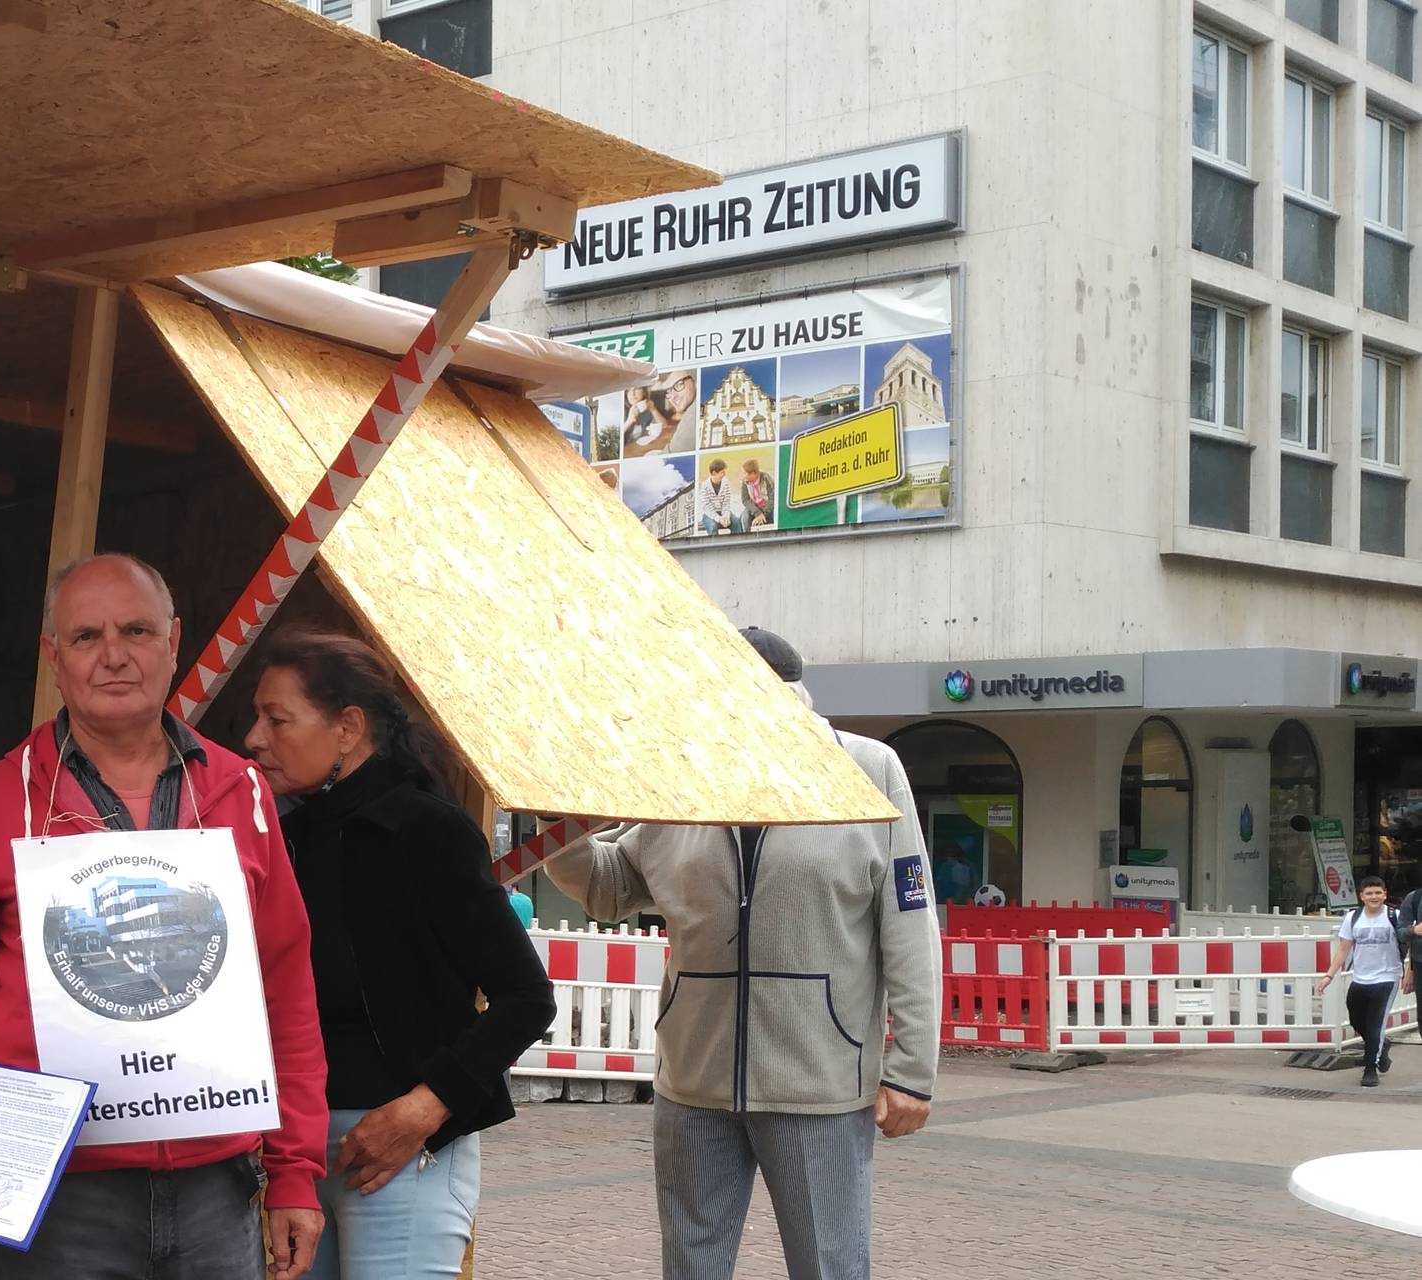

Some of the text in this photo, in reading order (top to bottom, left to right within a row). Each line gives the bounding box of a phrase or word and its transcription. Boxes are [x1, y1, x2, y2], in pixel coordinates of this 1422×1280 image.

[563, 163, 922, 270] NEUE RUHR ZEITUNG
[670, 311, 864, 363] HIER ZU HAUSE
[819, 431, 868, 456] Redaktion
[798, 448, 890, 486] Mülheim a. d. Ruhr
[981, 670, 1126, 701] unitymedia
[71, 855, 178, 885] Bürgerbegehren
[53, 933, 222, 1017] Erhalt unserer VHS in der MüGa
[120, 1050, 176, 1076] Hier
[85, 1079, 270, 1123] terschreiben!
